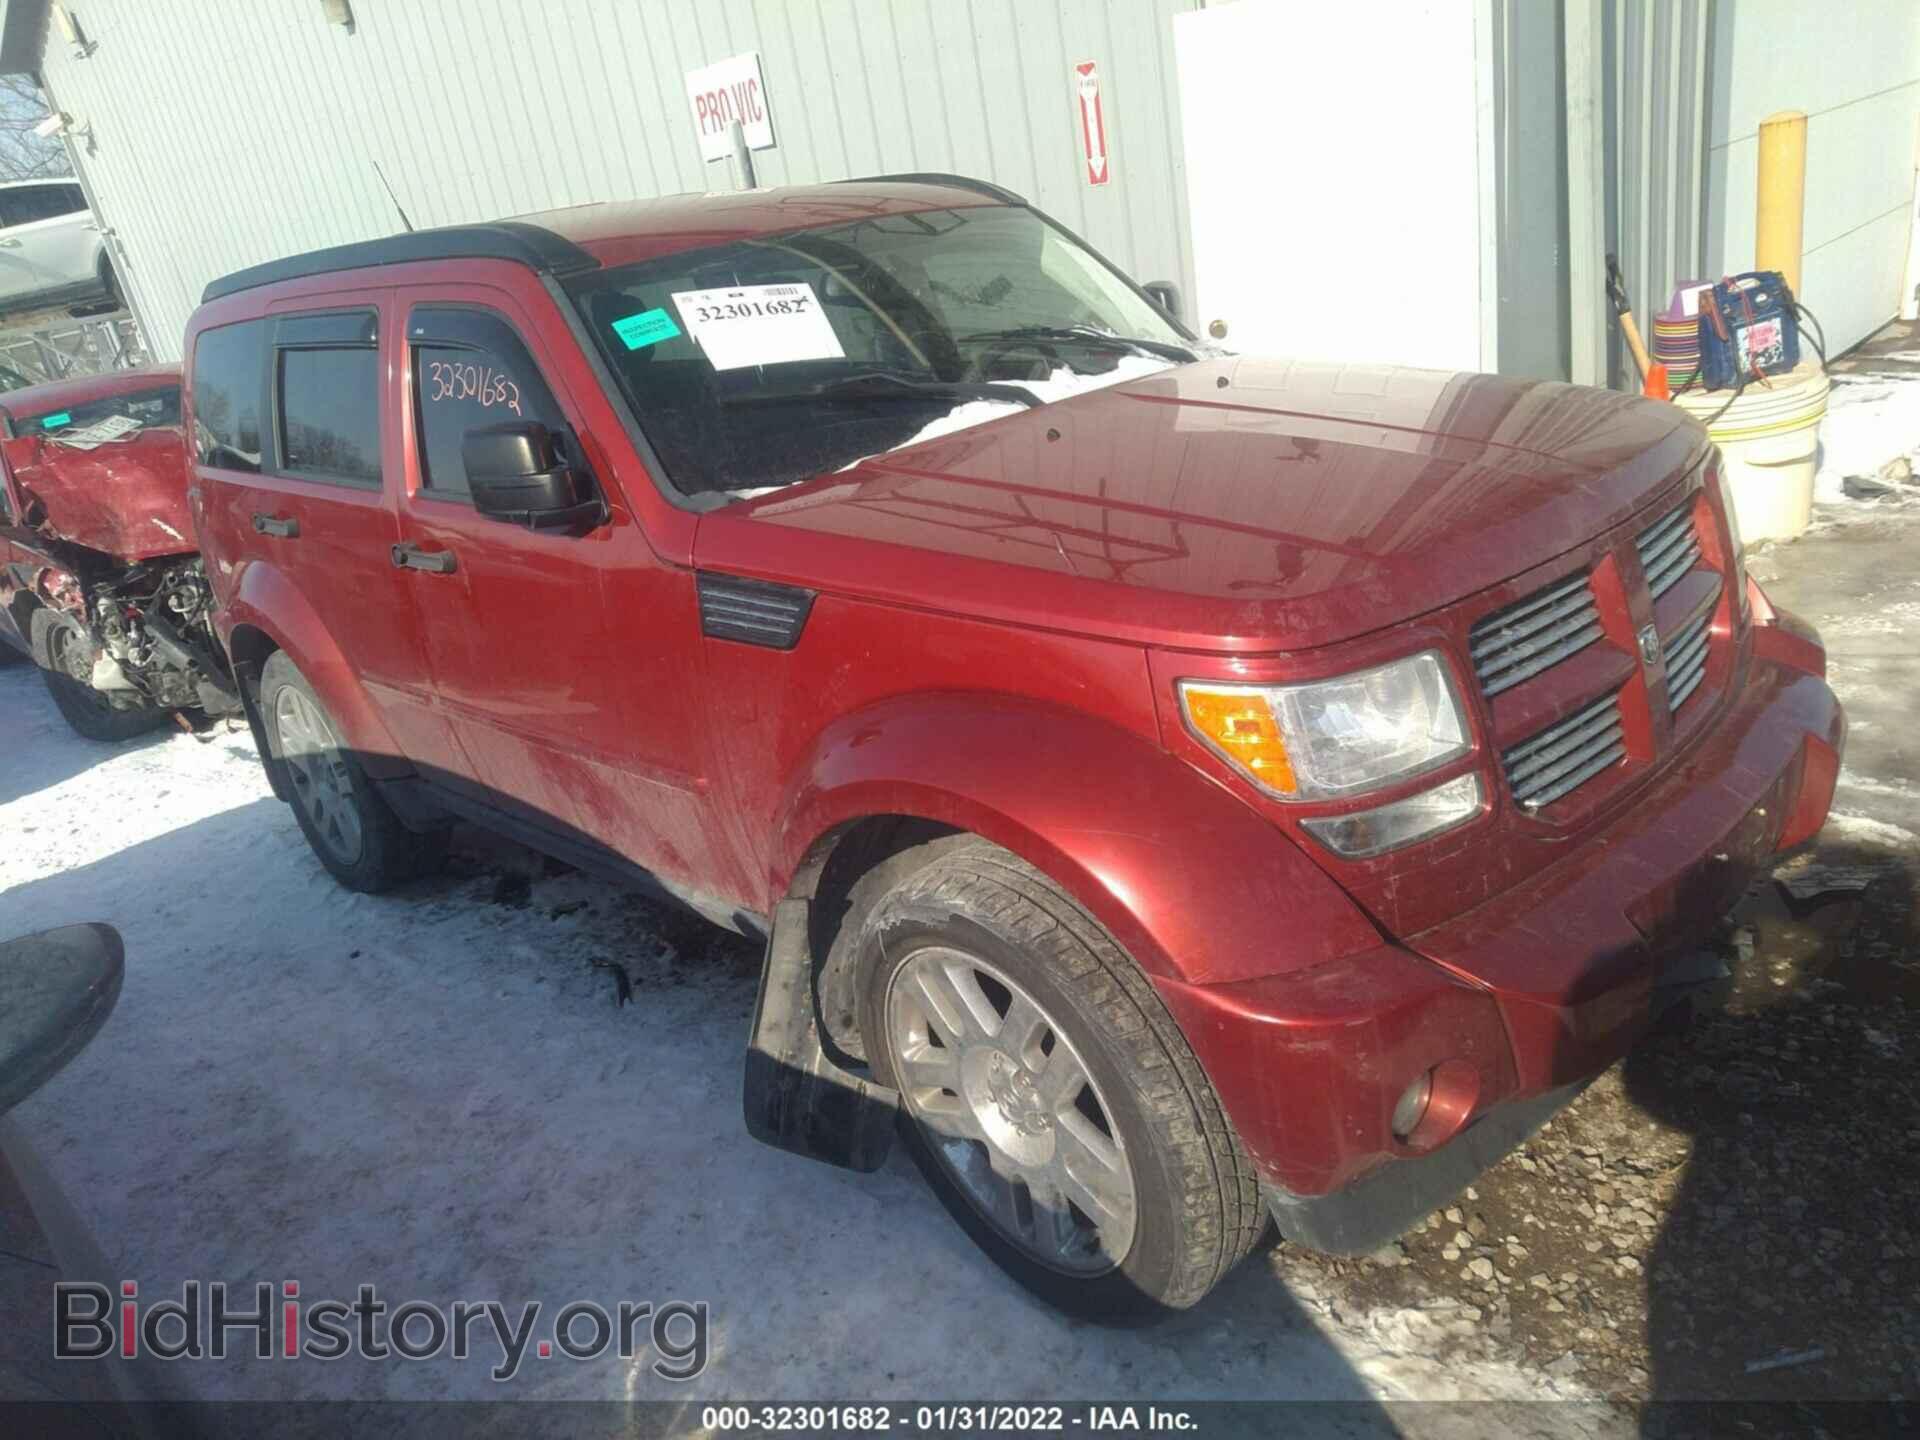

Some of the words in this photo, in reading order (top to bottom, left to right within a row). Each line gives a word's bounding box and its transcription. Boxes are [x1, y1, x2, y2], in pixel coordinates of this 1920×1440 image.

[695, 87, 734, 135] PRO
[730, 77, 762, 126] VIC
[696, 298, 804, 322] 32301682
[429, 361, 522, 416] 32301682
